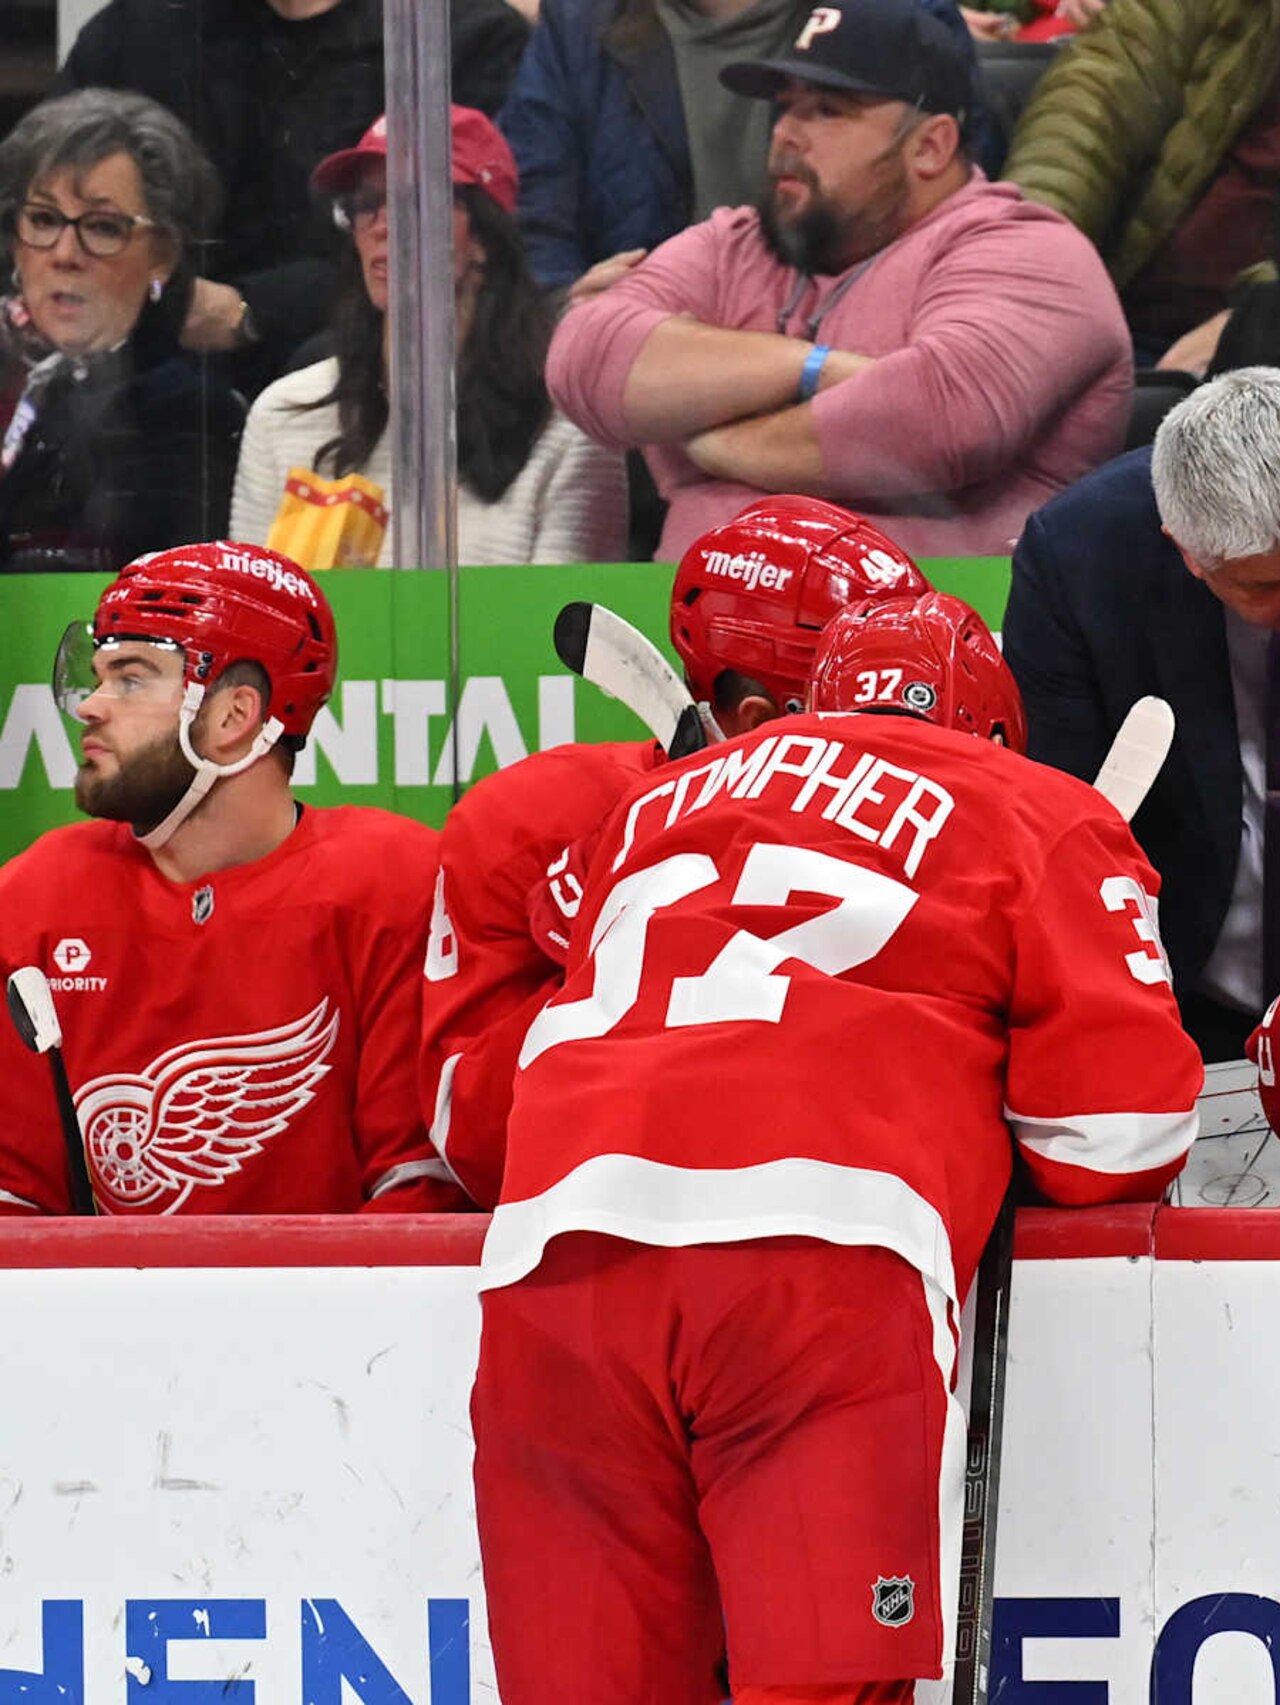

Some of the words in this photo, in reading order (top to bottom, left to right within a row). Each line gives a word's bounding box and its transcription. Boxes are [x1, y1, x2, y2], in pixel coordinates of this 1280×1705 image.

[795, 7, 842, 50] P
[217, 551, 318, 607] meijer
[701, 548, 793, 591] meijer
[855, 669, 902, 703] 37
[612, 735, 956, 881] COMPHER
[517, 842, 921, 1071] 37
[881, 1589, 909, 1617] NHL
